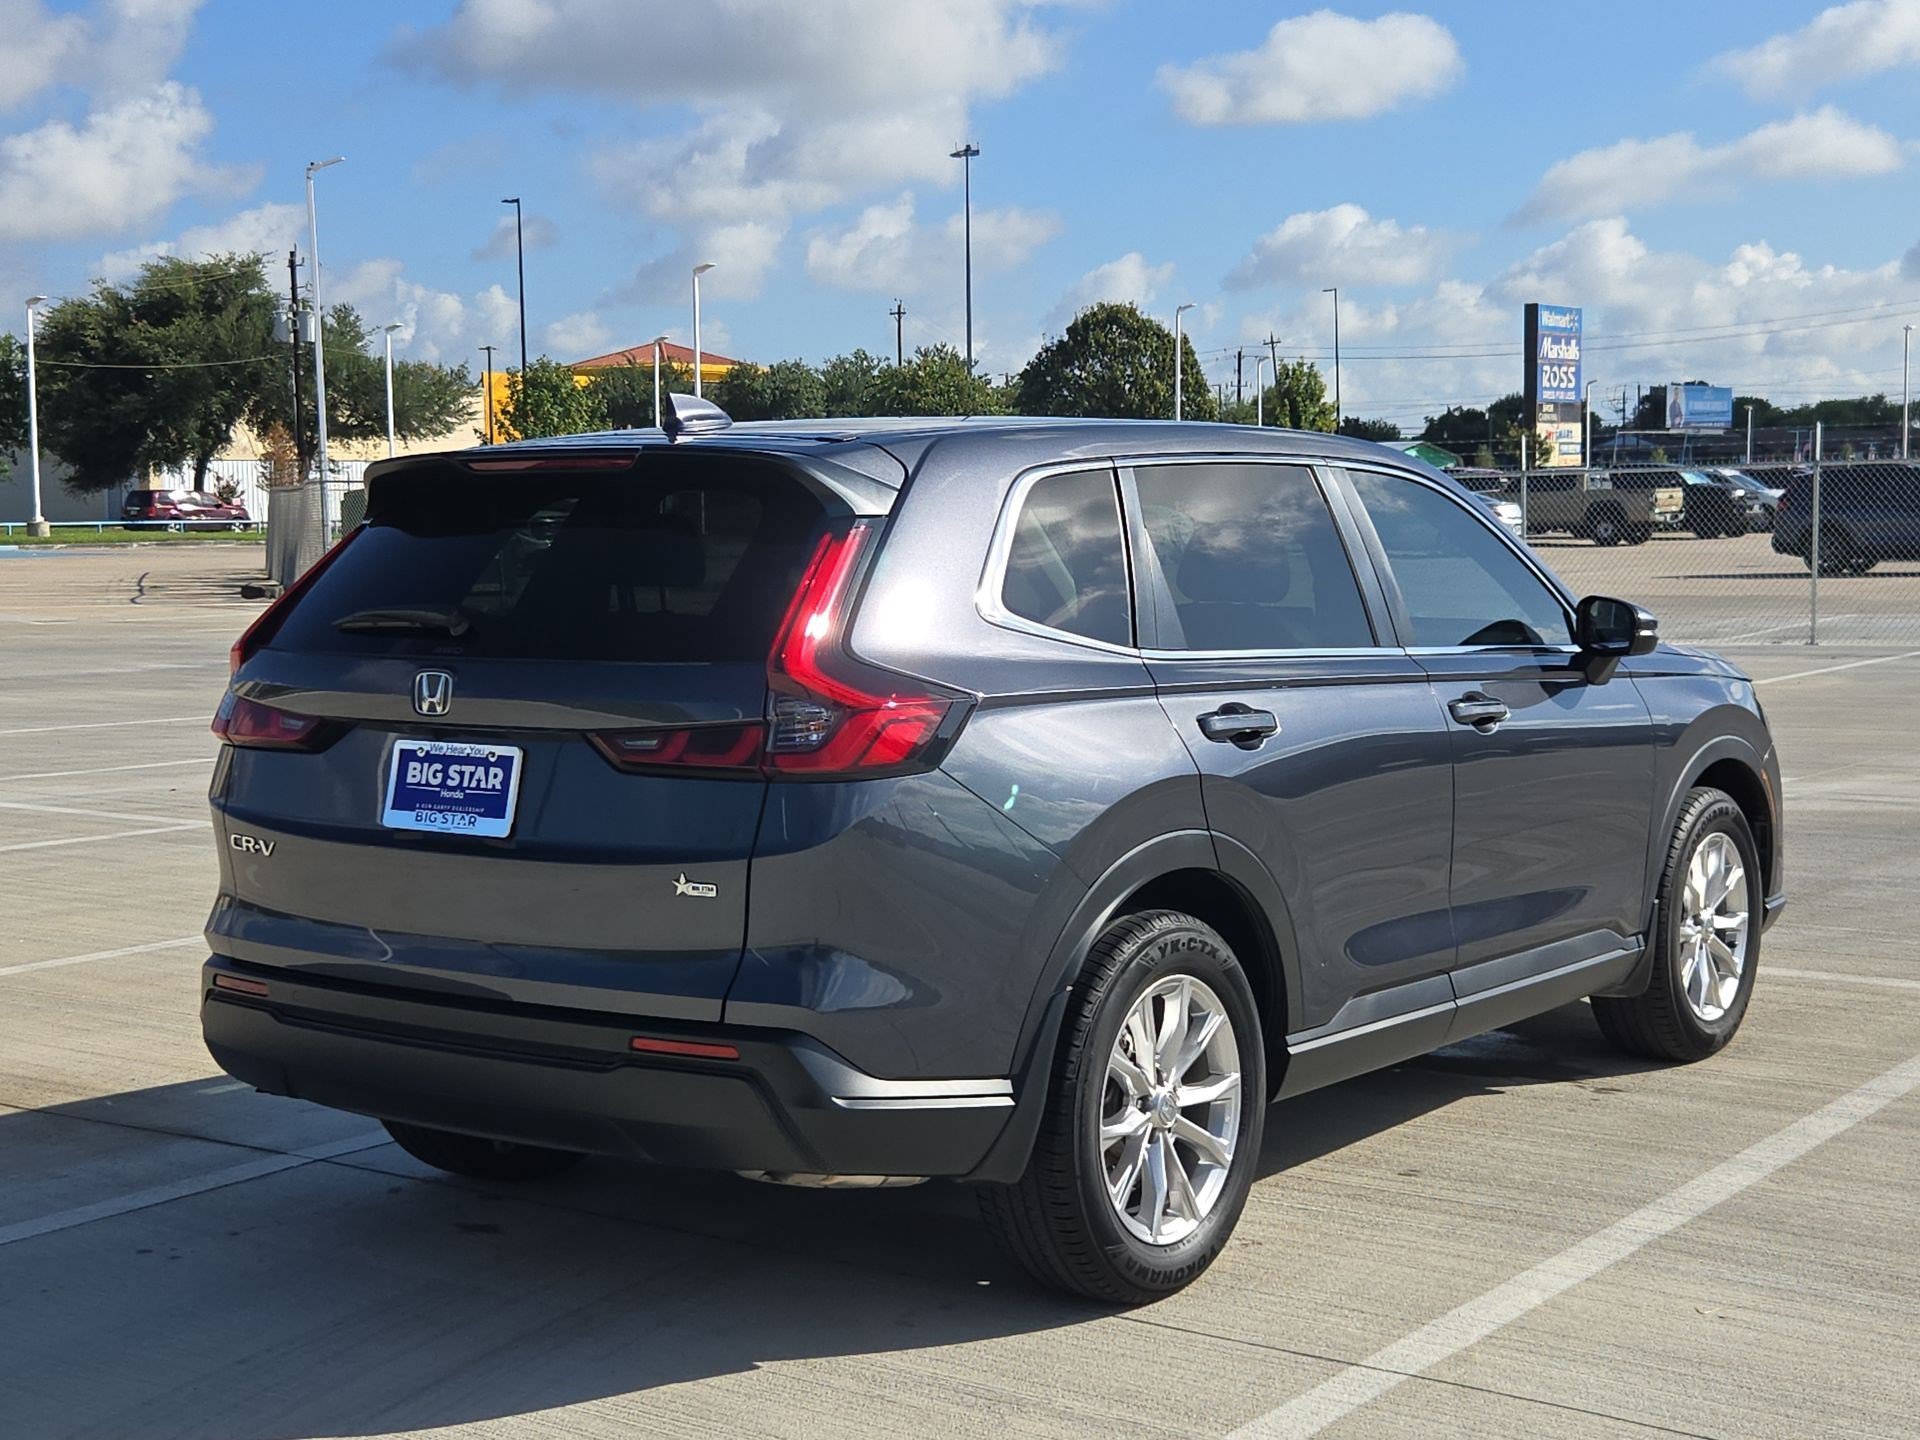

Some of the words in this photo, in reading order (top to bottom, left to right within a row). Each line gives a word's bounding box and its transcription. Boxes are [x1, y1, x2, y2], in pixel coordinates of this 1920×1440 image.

[1541, 310, 1571, 329] Walmart
[1539, 336, 1580, 361] Marshalls
[1542, 365, 1576, 389] ROSS
[429, 743, 444, 752] We
[445, 743, 467, 754] Hear
[468, 745, 487, 757] You
[406, 761, 444, 785] BIG
[446, 764, 504, 790] STAR
[439, 788, 464, 799] Honda
[415, 810, 438, 824] BIG
[440, 813, 478, 827] STAR
